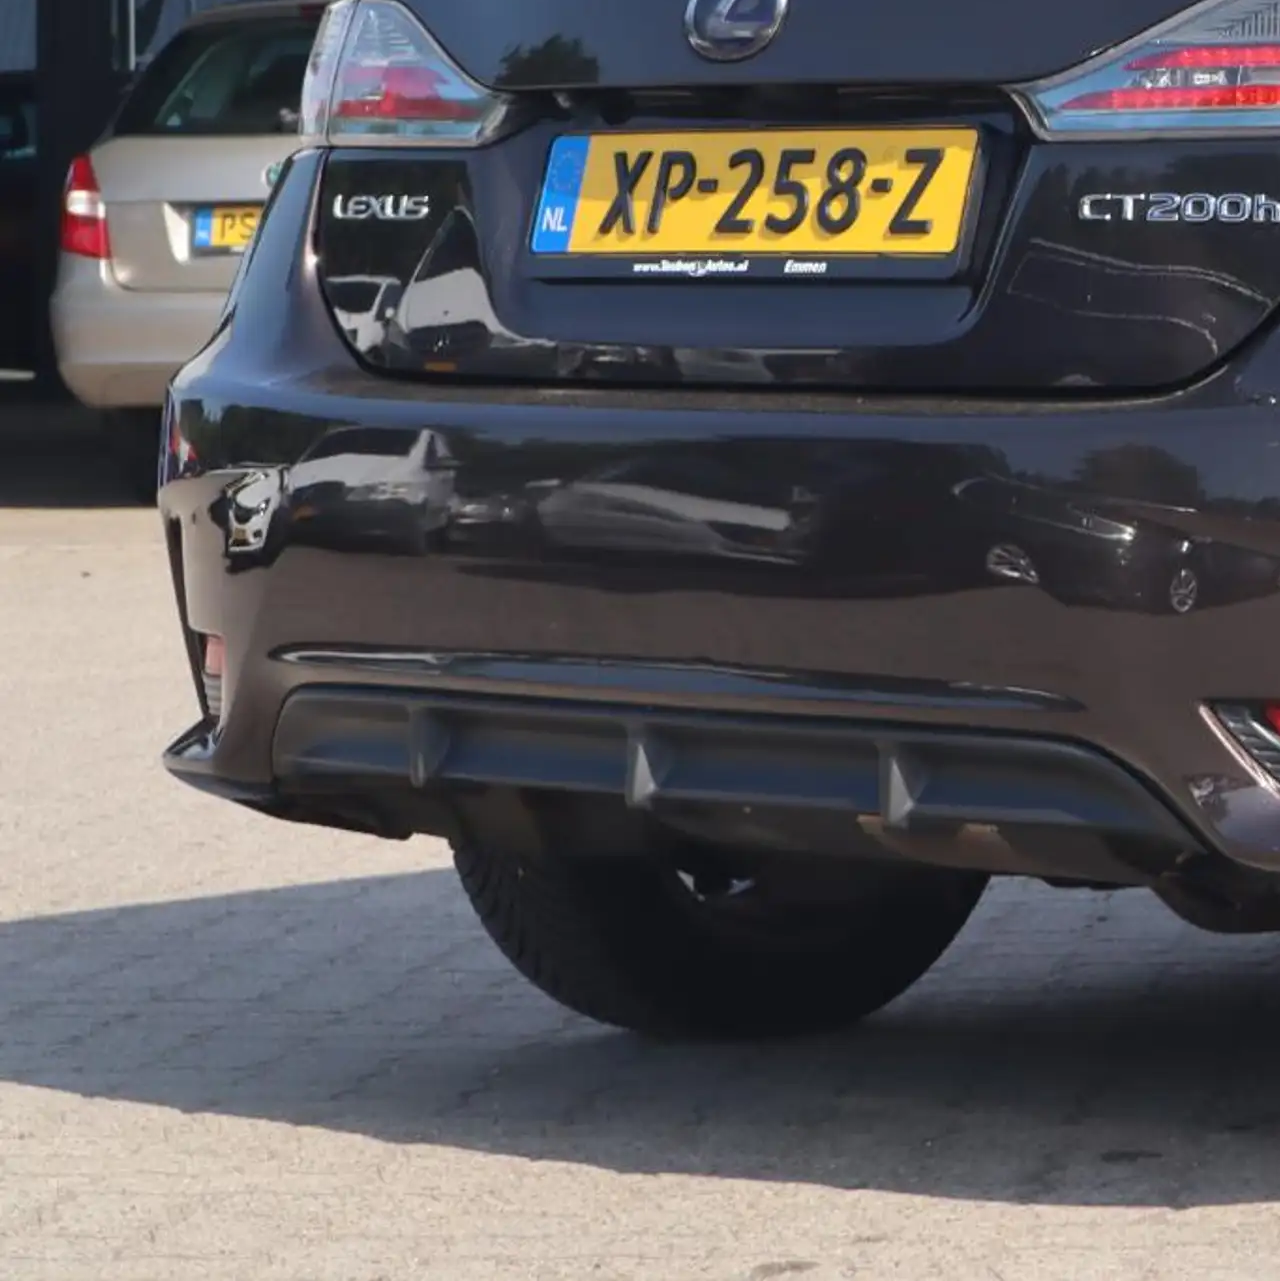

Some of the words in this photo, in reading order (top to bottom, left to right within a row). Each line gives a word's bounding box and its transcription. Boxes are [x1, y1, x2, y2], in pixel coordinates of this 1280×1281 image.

[332, 194, 429, 220] LEXUS
[541, 207, 568, 233] NL
[598, 147, 946, 236] XP-258-Z
